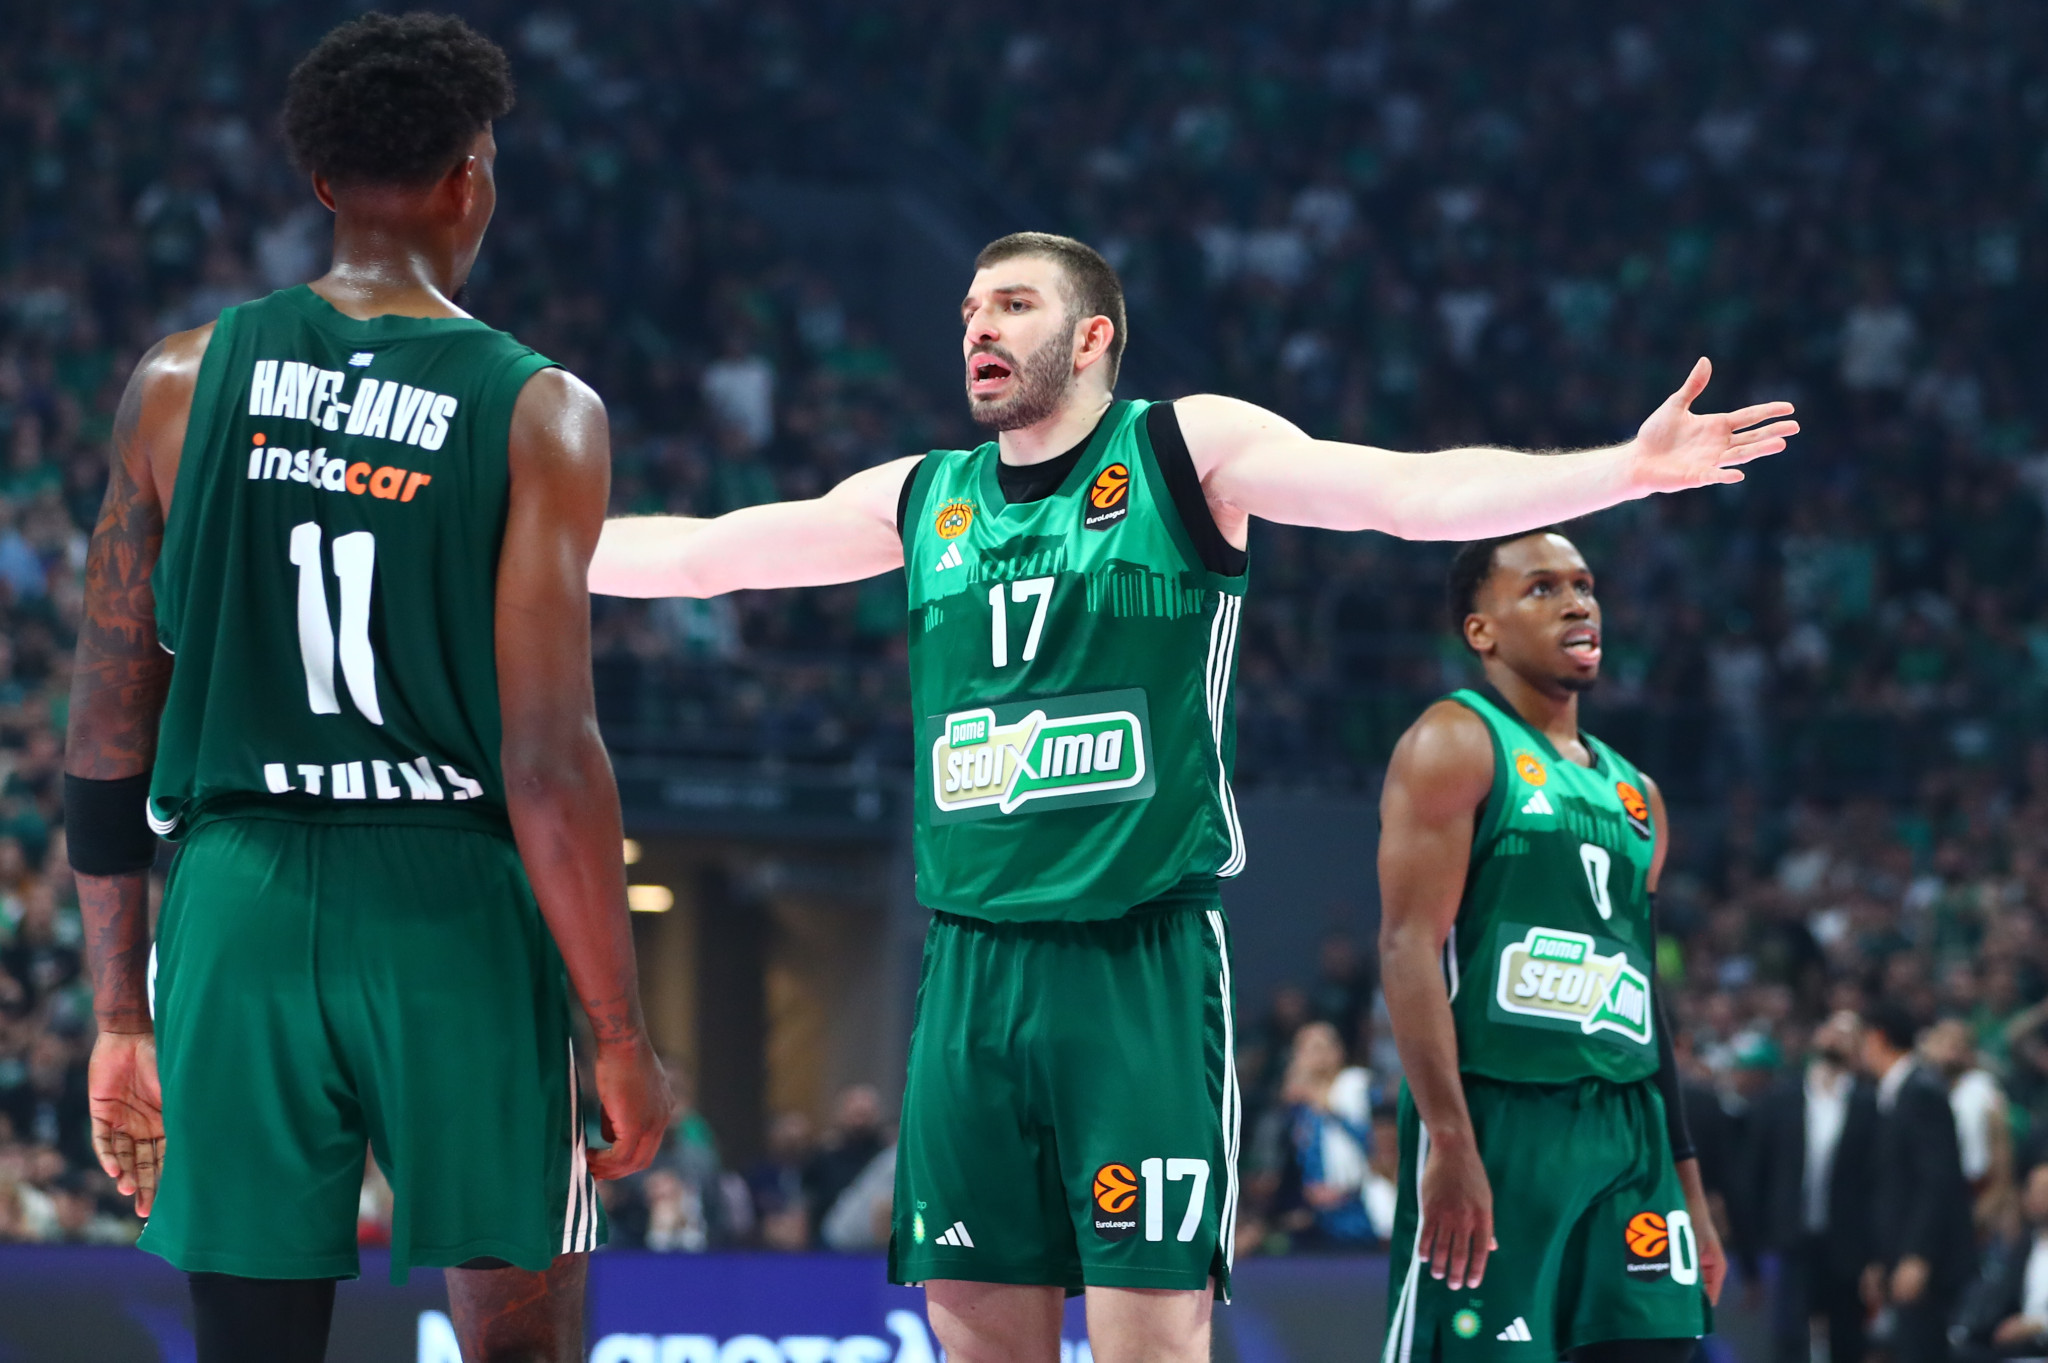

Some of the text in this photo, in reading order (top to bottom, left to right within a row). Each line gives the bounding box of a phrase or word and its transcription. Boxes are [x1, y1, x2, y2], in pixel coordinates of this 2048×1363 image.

[248, 432, 432, 502] instacar
[289, 521, 384, 726] 11
[988, 576, 1055, 668] 17
[952, 720, 986, 746] pame
[1533, 938, 1582, 961] pame
[1095, 1220, 1136, 1230] EuroLeague
[1141, 1157, 1210, 1242] 17
[1666, 1209, 1698, 1285] 0
